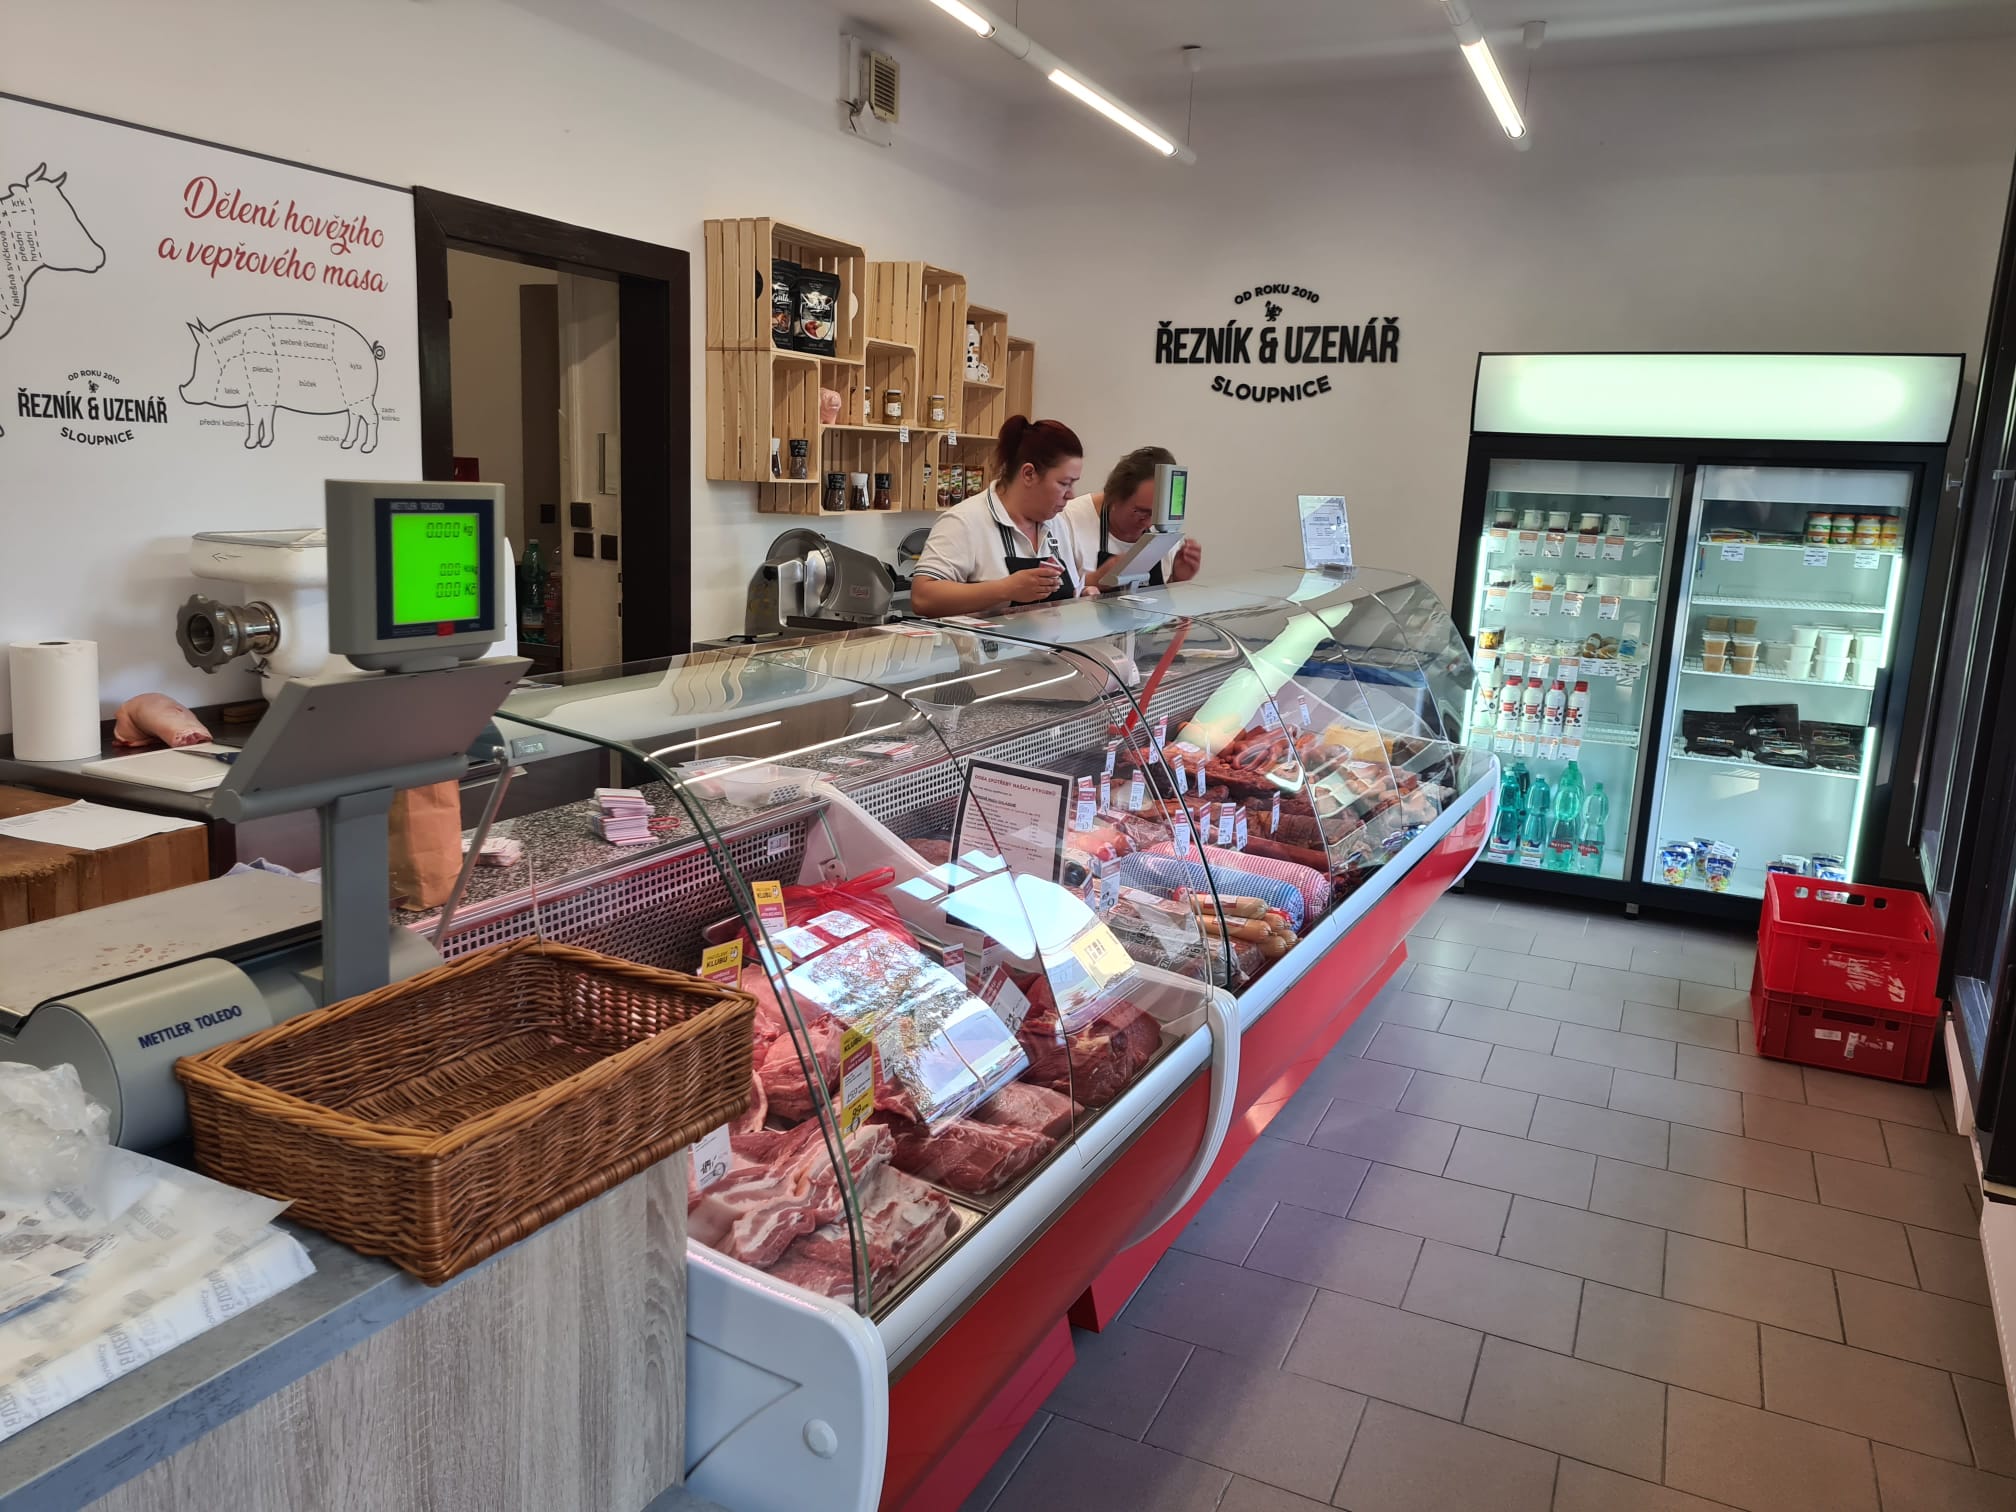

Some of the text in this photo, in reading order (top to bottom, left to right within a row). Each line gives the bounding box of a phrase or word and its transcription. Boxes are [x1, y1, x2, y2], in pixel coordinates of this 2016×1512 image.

[11, 198, 26, 207] krk
[183, 175, 385, 256] Dělení hovězího
[158, 236, 389, 293] a vepřového masa
[1234, 283, 1320, 305] OD ROKU 2010
[1155, 316, 1400, 364] ŘEZNÍK & UZENÁŘ
[68, 369, 121, 385] OD ROKU 2010
[1211, 374, 1332, 404] SLOUPNICE
[18, 387, 168, 424] ŘEZNÍK & UZENÁŘ
[60, 426, 135, 446] SLOUPNICE
[706, 955, 728, 969] KLUBU
[138, 1005, 243, 1049] METTLER TOLEDO
